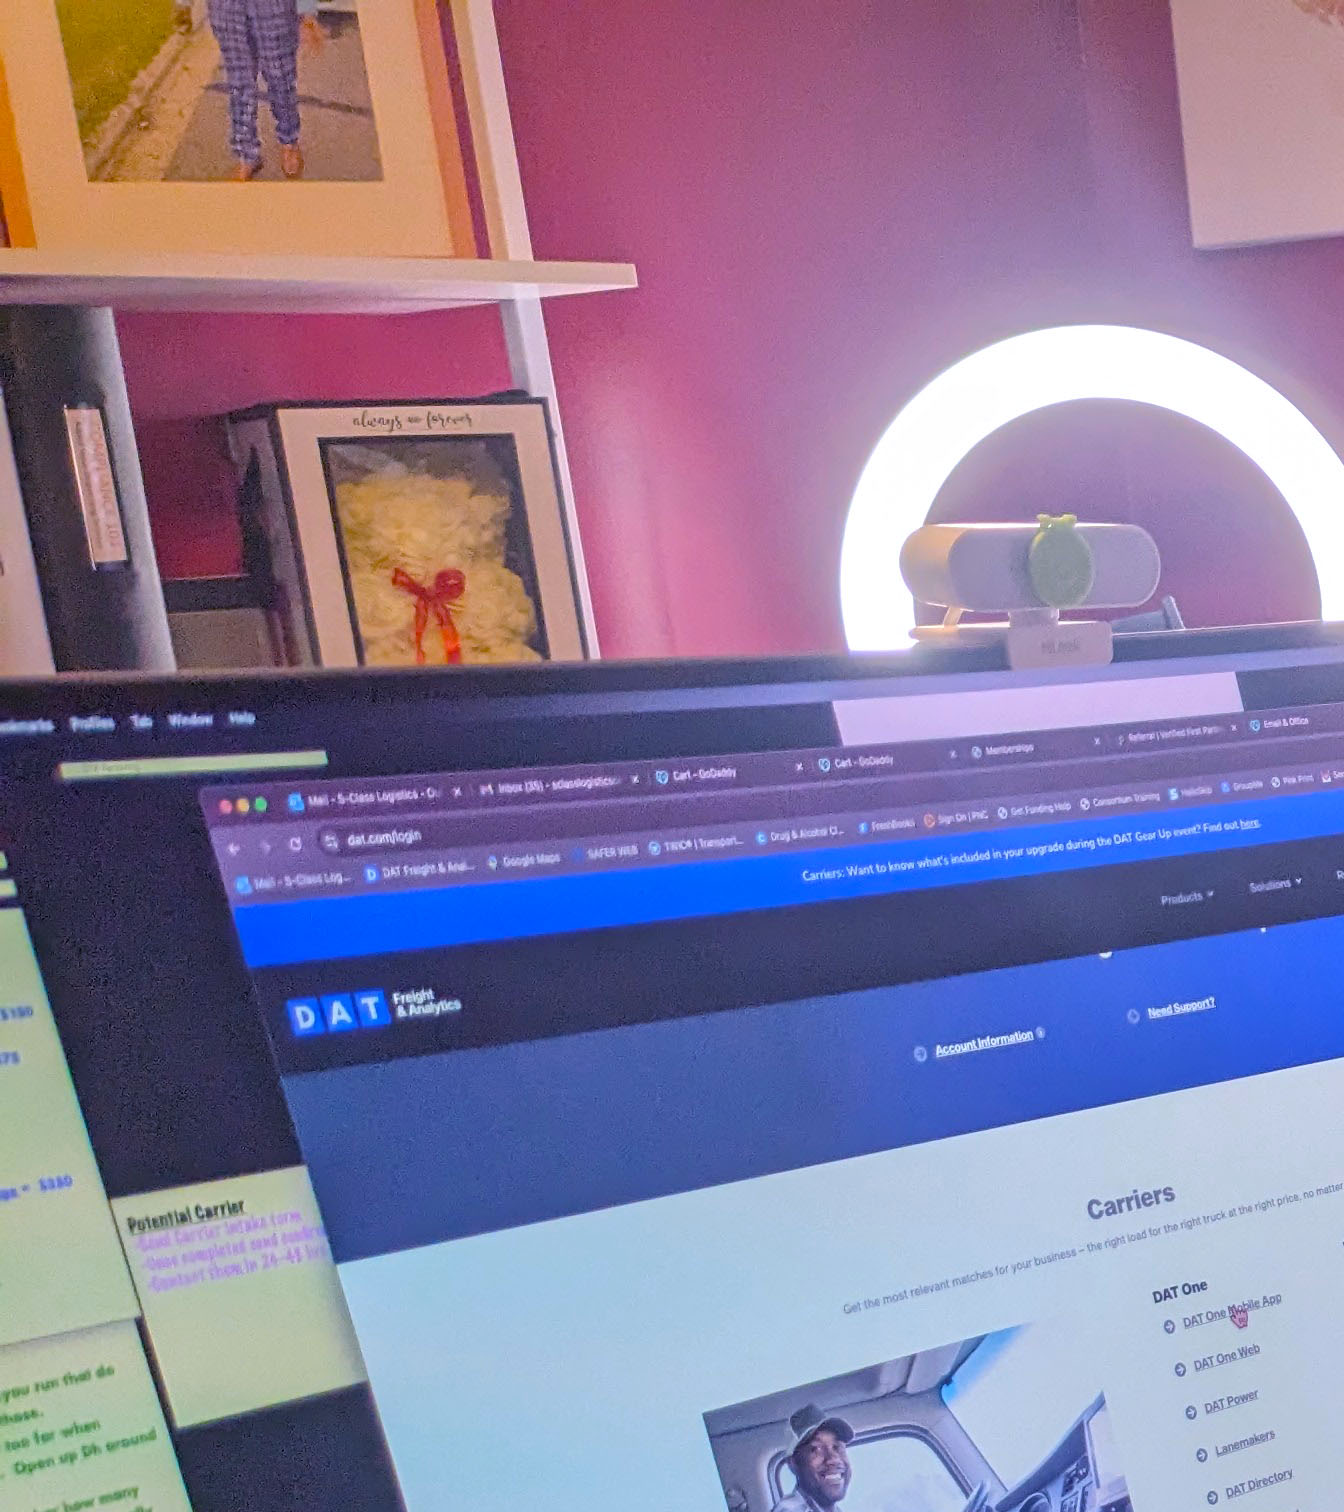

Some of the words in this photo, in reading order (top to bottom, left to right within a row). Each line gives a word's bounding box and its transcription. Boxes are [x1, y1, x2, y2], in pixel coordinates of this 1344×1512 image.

[353, 410, 402, 432] always
[347, 829, 423, 847] dat.com/login
[802, 866, 844, 882] Carriers:
[846, 863, 873, 877] Want
[875, 863, 885, 873] to
[888, 859, 915, 873] know
[917, 854, 949, 869] what's
[951, 850, 991, 864] included
[993, 848, 1002, 859] in
[1003, 848, 1025, 861] your
[1026, 841, 1065, 858] upgrade
[1066, 838, 1096, 854] during
[1096, 834, 1112, 847] the
[1113, 832, 1133, 845] DAT
[1136, 828, 1157, 842] Gear
[1158, 827, 1172, 841] Up
[1172, 823, 1201, 838] event?
[1203, 821, 1222, 834] Find
[1223, 820, 1239, 832] out
[1161, 891, 1203, 907] Products
[1249, 878, 1291, 894] Solutions
[392, 987, 436, 1005] Freight
[409, 999, 462, 1016] Analytics
[1148, 1006, 1170, 1020] Need
[1172, 996, 1216, 1016] Support?
[294, 996, 379, 1030] DAT
[935, 1039, 976, 1058] Account
[978, 1029, 1034, 1050] Information
[127, 1208, 193, 1234] Potential
[195, 1199, 246, 1224] Carrier
[1087, 1186, 1177, 1221] Carriers
[843, 1301, 862, 1315] Get
[863, 1297, 881, 1310] the
[882, 1290, 908, 1304] most
[910, 1279, 950, 1297] relevant
[951, 1269, 994, 1287] matches
[994, 1263, 1009, 1276] for
[1010, 1258, 1033, 1274] your
[1034, 1247, 1077, 1266] business
[1086, 1241, 1103, 1254] the
[1104, 1234, 1126, 1250] right
[1127, 1229, 1148, 1243] load
[1148, 1226, 1162, 1239] for
[1163, 1222, 1179, 1234] the
[1180, 1216, 1202, 1232] right
[1202, 1210, 1227, 1224] truck
[1228, 1207, 1238, 1218] at
[1238, 1203, 1254, 1215] the
[1254, 1198, 1277, 1213] right
[1303, 1189, 1315, 1200] no
[1316, 1182, 1344, 1197] matter
[1152, 1286, 1179, 1304] DAT
[1181, 1279, 1208, 1297] One
[1183, 1312, 1205, 1330] DAT
[1205, 1307, 1227, 1324] One
[1227, 1297, 1260, 1317] Mobile
[1262, 1292, 1283, 1310] App
[1193, 1355, 1216, 1373] DAT
[1216, 1350, 1237, 1367] One
[1238, 1343, 1261, 1361] Web
[1204, 1398, 1226, 1415] DAT
[1226, 1389, 1259, 1410] Power
[1214, 1429, 1276, 1458] Lanemakers
[1225, 1483, 1246, 1500] DAT
[1247, 1467, 1294, 1494] Directory
